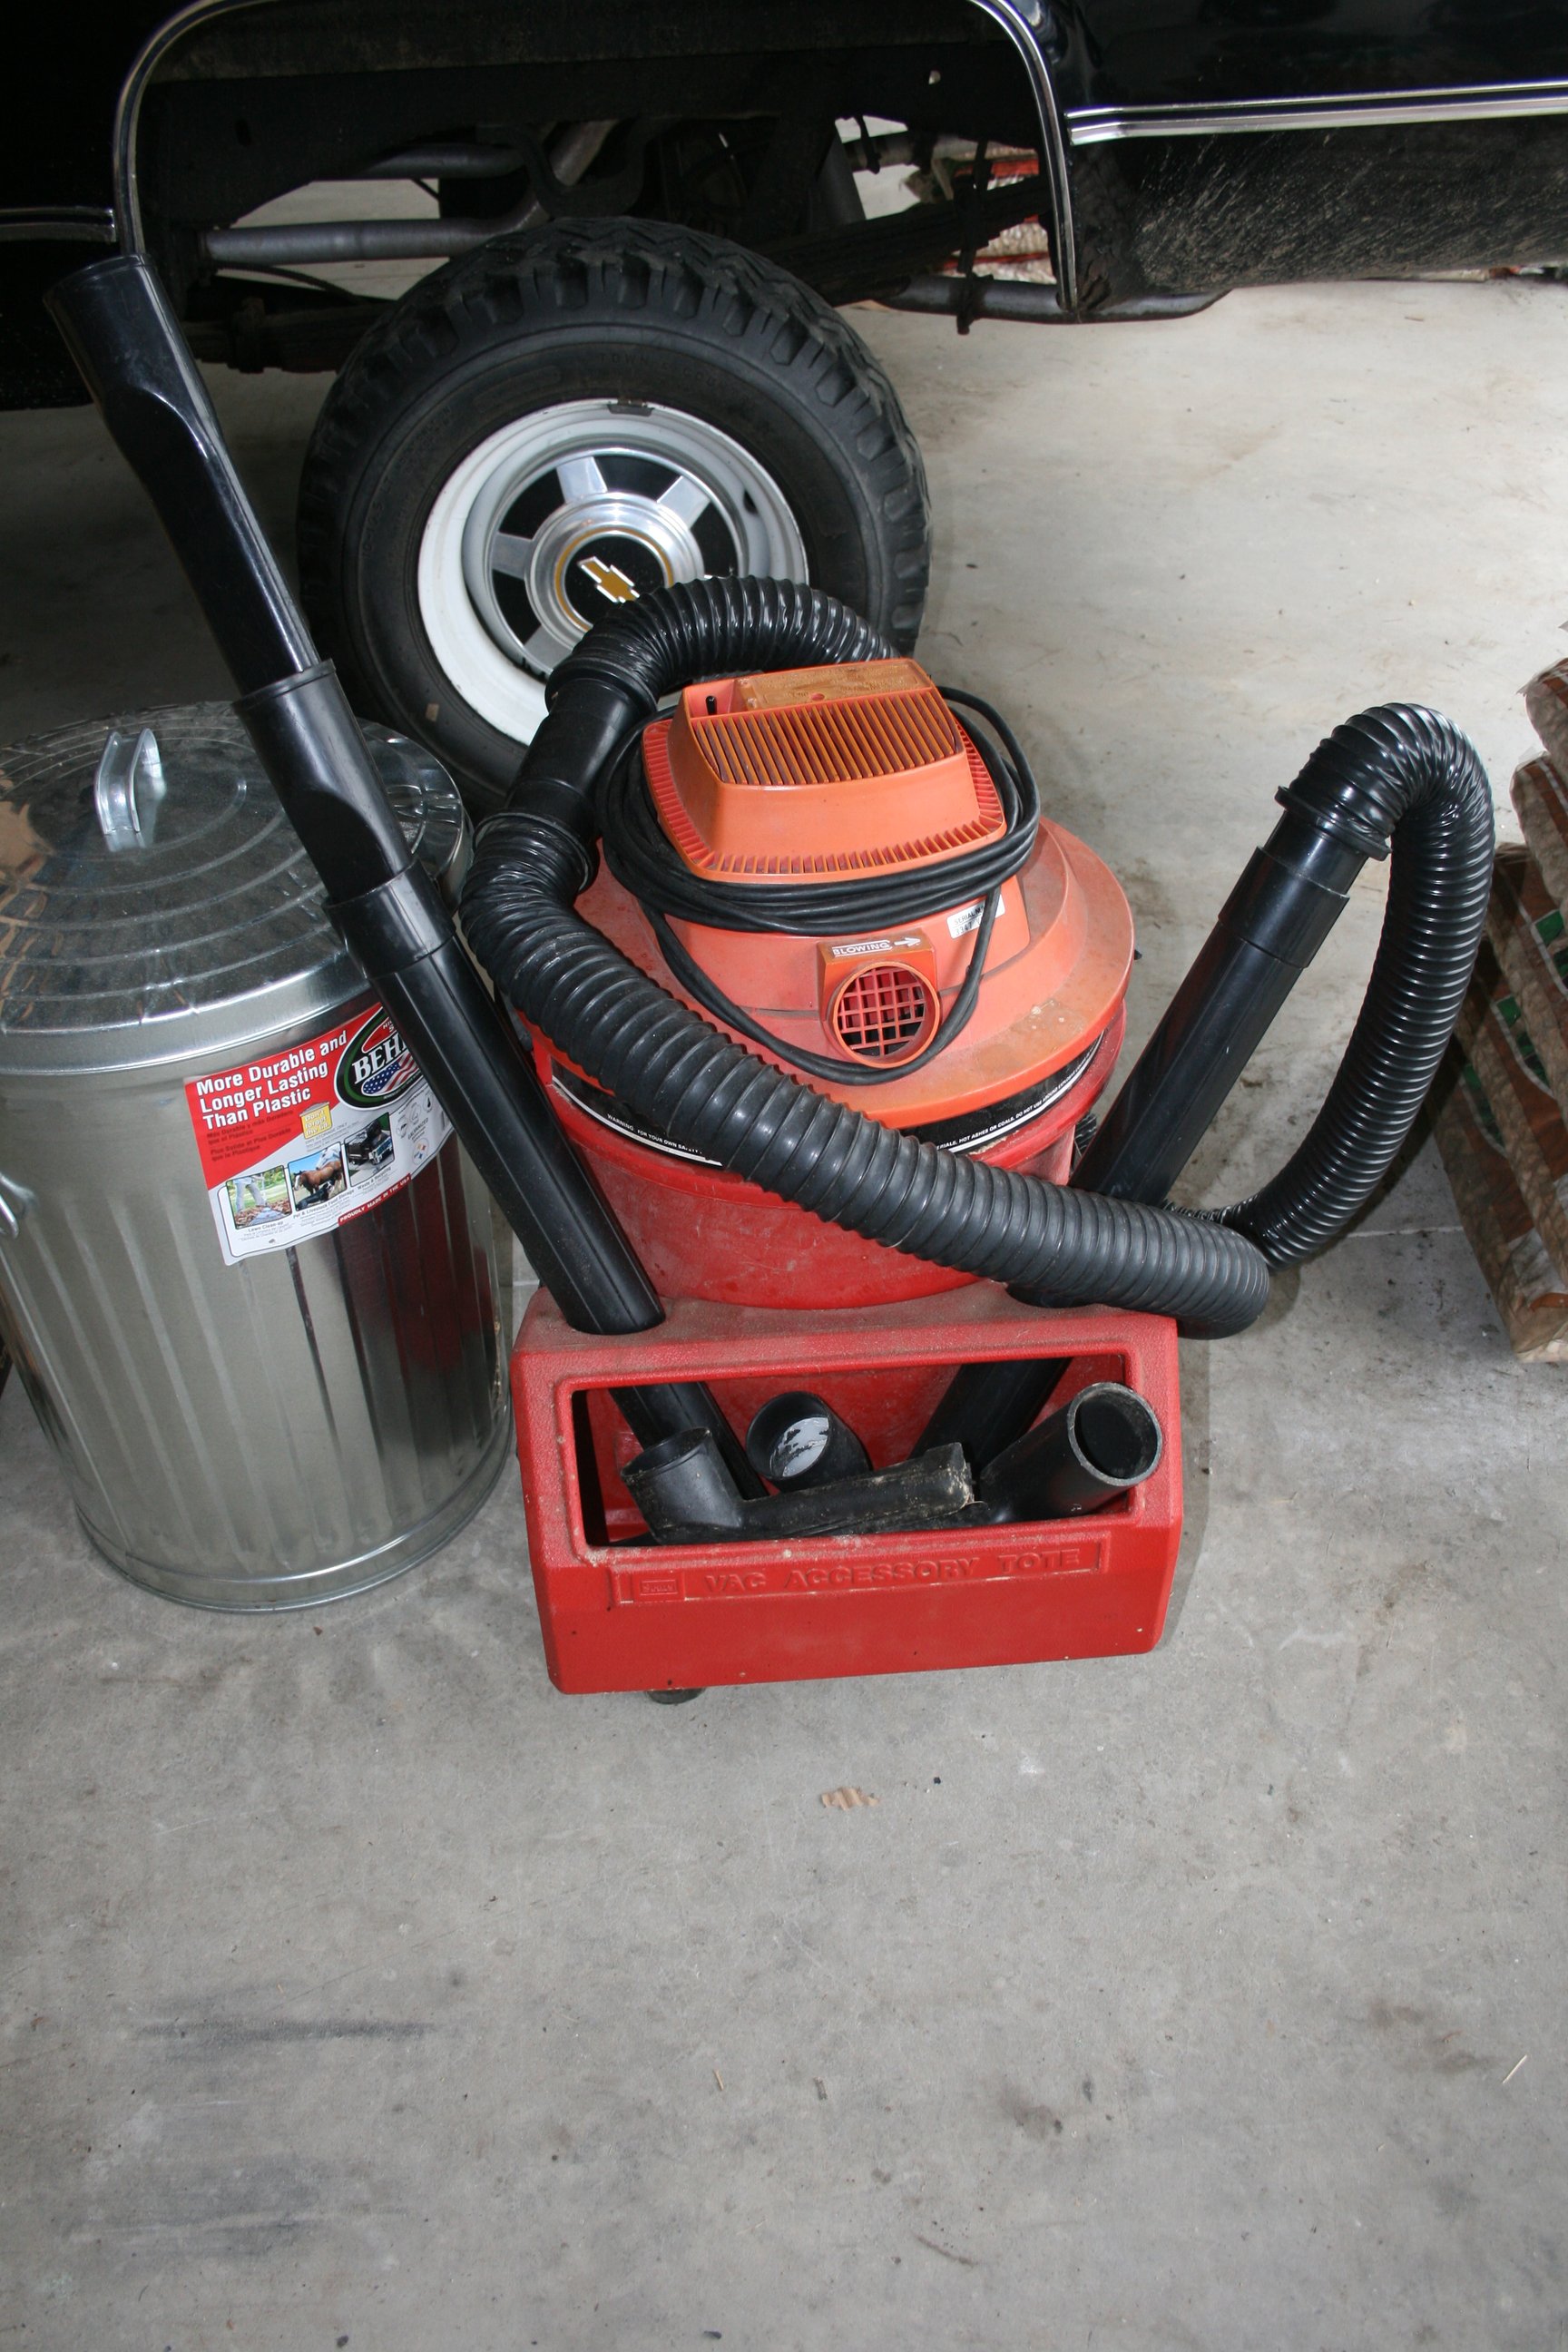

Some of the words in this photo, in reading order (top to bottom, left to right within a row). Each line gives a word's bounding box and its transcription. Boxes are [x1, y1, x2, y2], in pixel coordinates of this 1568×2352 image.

[954, 910, 975, 926] SERIAL
[833, 942, 890, 956] BLOWING
[196, 1072, 243, 1096] More
[248, 1047, 315, 1083] Durable
[319, 1030, 348, 1056] and
[200, 1085, 263, 1113] Longer
[267, 1061, 328, 1095] Lasting
[202, 1108, 250, 1131] Than
[252, 1086, 311, 1118] Plastic
[958, 1135, 971, 1143] HOT
[971, 1128, 989, 1139] ASHES
[1023, 1104, 1034, 1114] NOT
[607, 1113, 634, 1132] WARNING
[637, 1129, 648, 1137] FOR
[648, 1133, 663, 1143] YOUR
[663, 1139, 677, 1148] OWN
[339, 1206, 366, 1222] PROUDLY
[367, 1196, 382, 1209] MADE
[389, 1184, 399, 1193] THE
[705, 1572, 766, 1593] VAC
[784, 1555, 980, 1590] ACCESSORY
[996, 1548, 1081, 1572] TOTE
